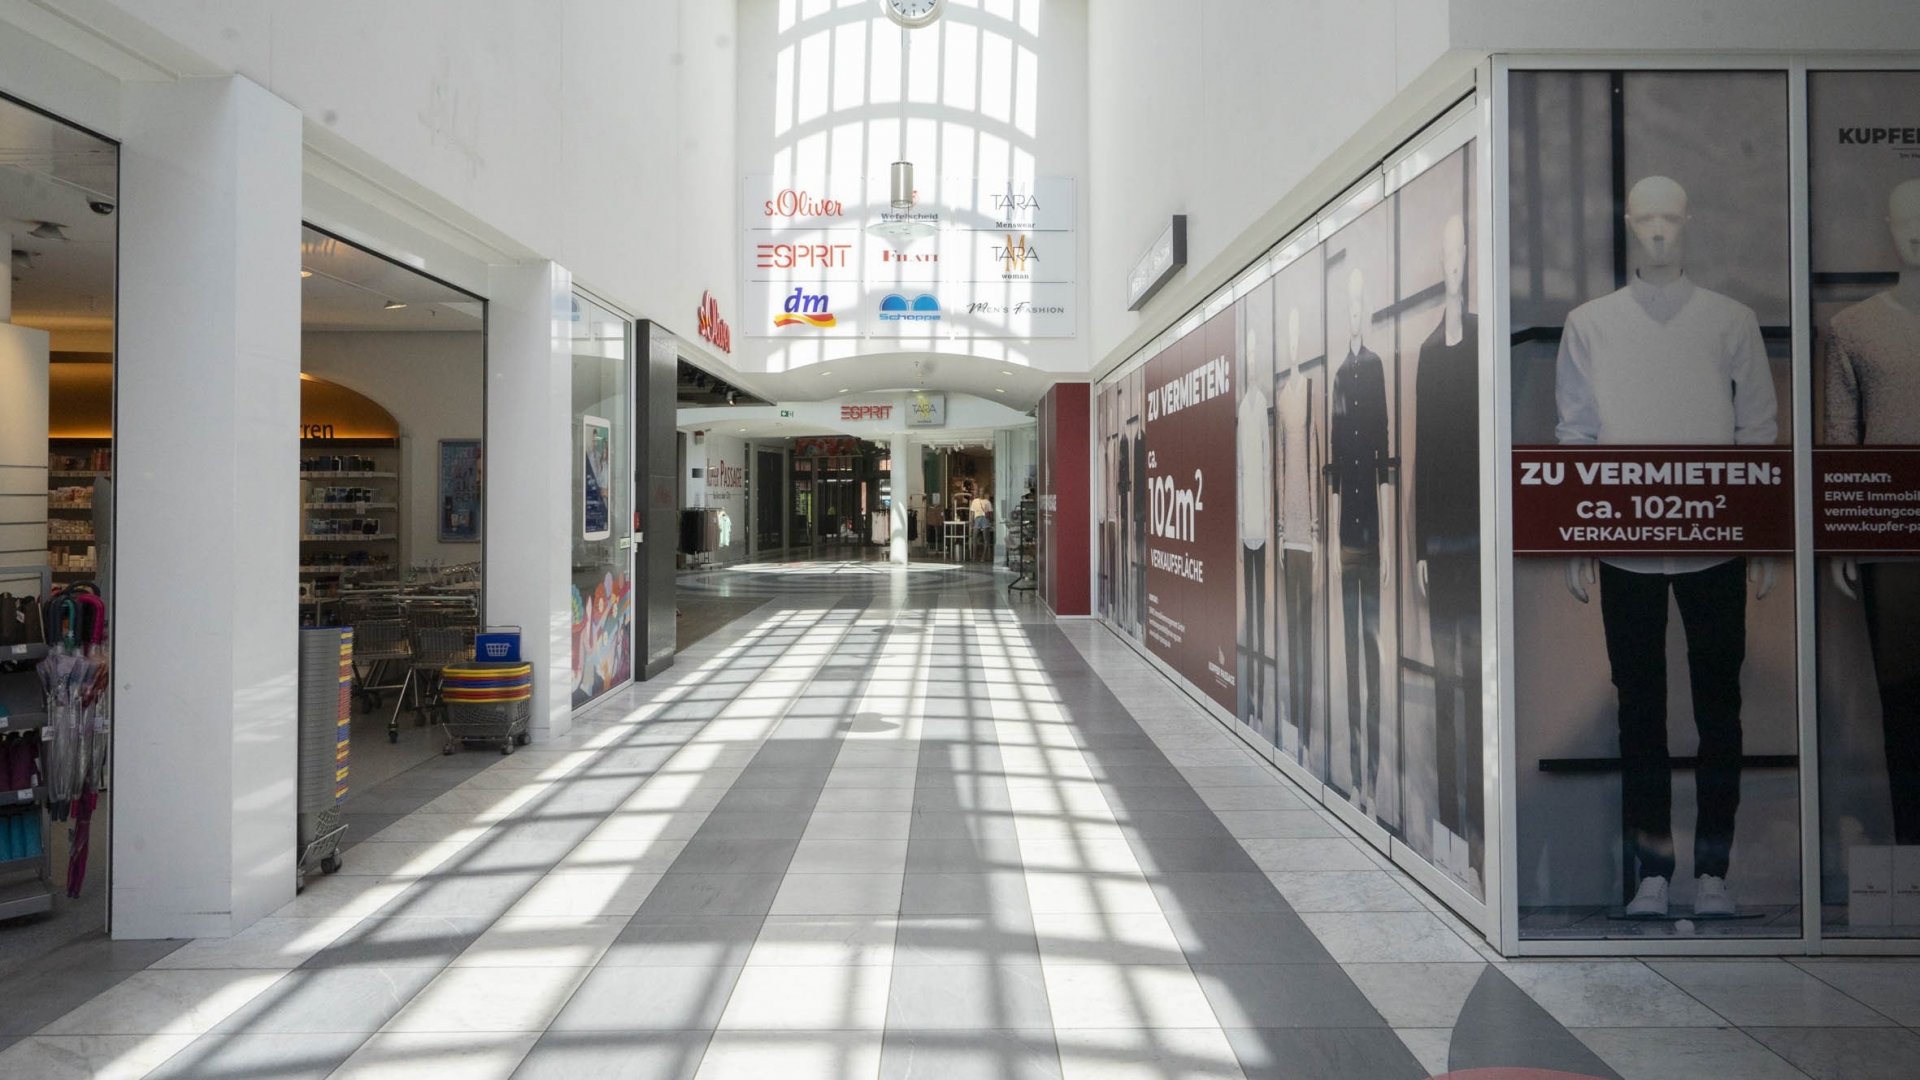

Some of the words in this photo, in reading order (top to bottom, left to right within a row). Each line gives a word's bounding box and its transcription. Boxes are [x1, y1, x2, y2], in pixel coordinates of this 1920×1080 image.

[1838, 127, 1920, 145] KUPFE
[764, 188, 845, 217] s.Oliver
[989, 194, 1041, 210] TARA
[996, 221, 1036, 229] Menswear
[756, 244, 852, 268] ESPRIT
[991, 246, 1040, 262] TARA
[784, 286, 830, 313] dm
[879, 313, 941, 322] Schoppe
[1147, 388, 1160, 422] ZU
[1160, 354, 1230, 417] VERMIETEN:
[840, 405, 893, 420] ESPRIT
[1520, 462, 1565, 486] ZU
[1575, 461, 1781, 486] VERMIETEN:
[1824, 472, 1892, 483] KONTAKT:
[1824, 491, 1865, 501] ERWE
[1576, 500, 1622, 520] ca.
[1631, 494, 1727, 520] 102m²
[1559, 522, 1744, 542] VERKAUFSFLÄCHE
[1150, 548, 1203, 583] VERKAUFSFLÄCHE
